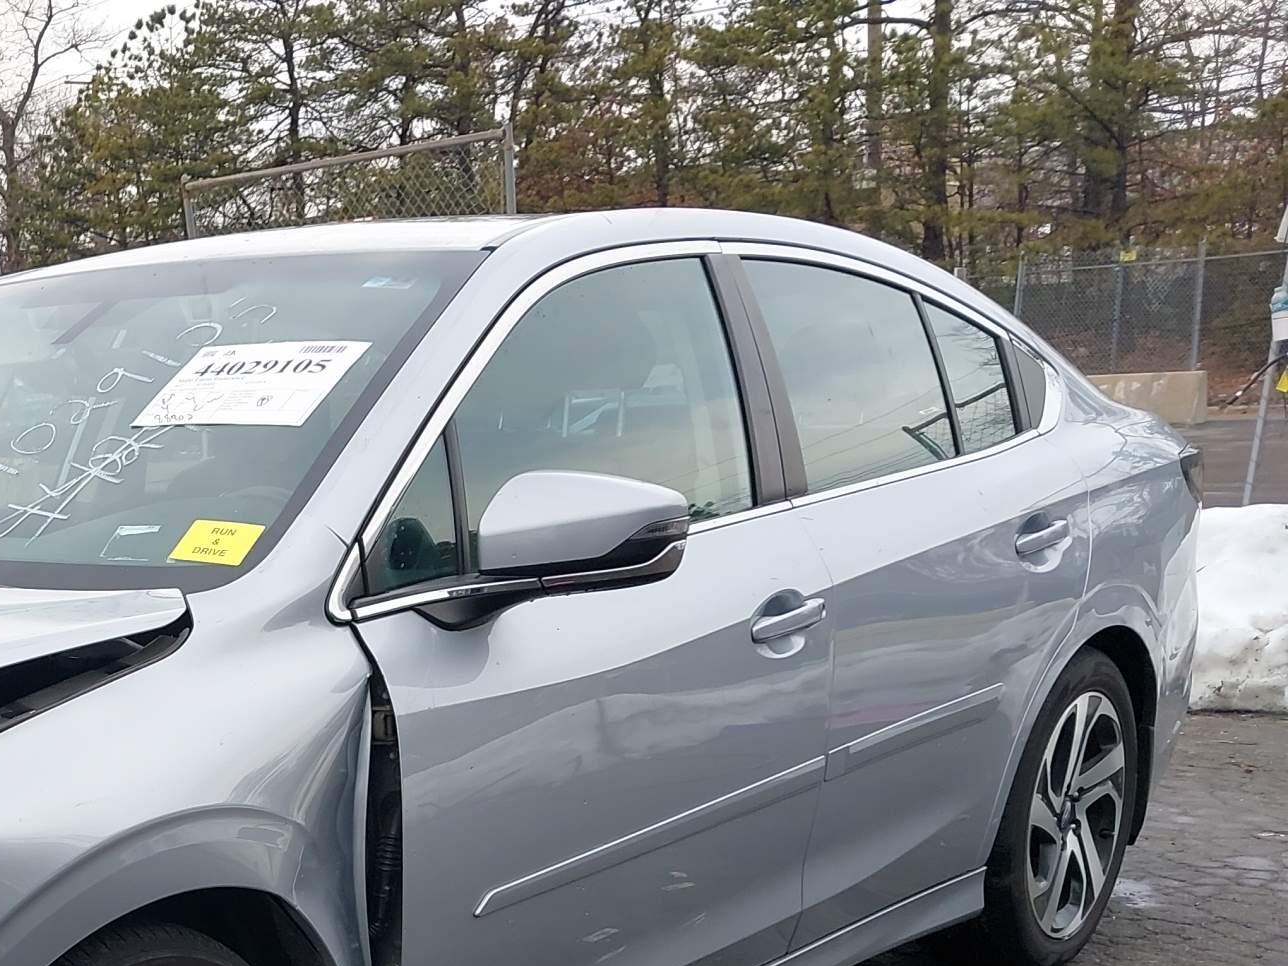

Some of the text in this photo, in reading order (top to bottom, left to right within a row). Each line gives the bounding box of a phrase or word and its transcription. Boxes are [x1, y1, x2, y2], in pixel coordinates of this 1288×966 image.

[194, 358, 333, 377] 44029105
[210, 527, 238, 537] RUN
[211, 538, 221, 546] &
[191, 546, 229, 557] DRIVE
